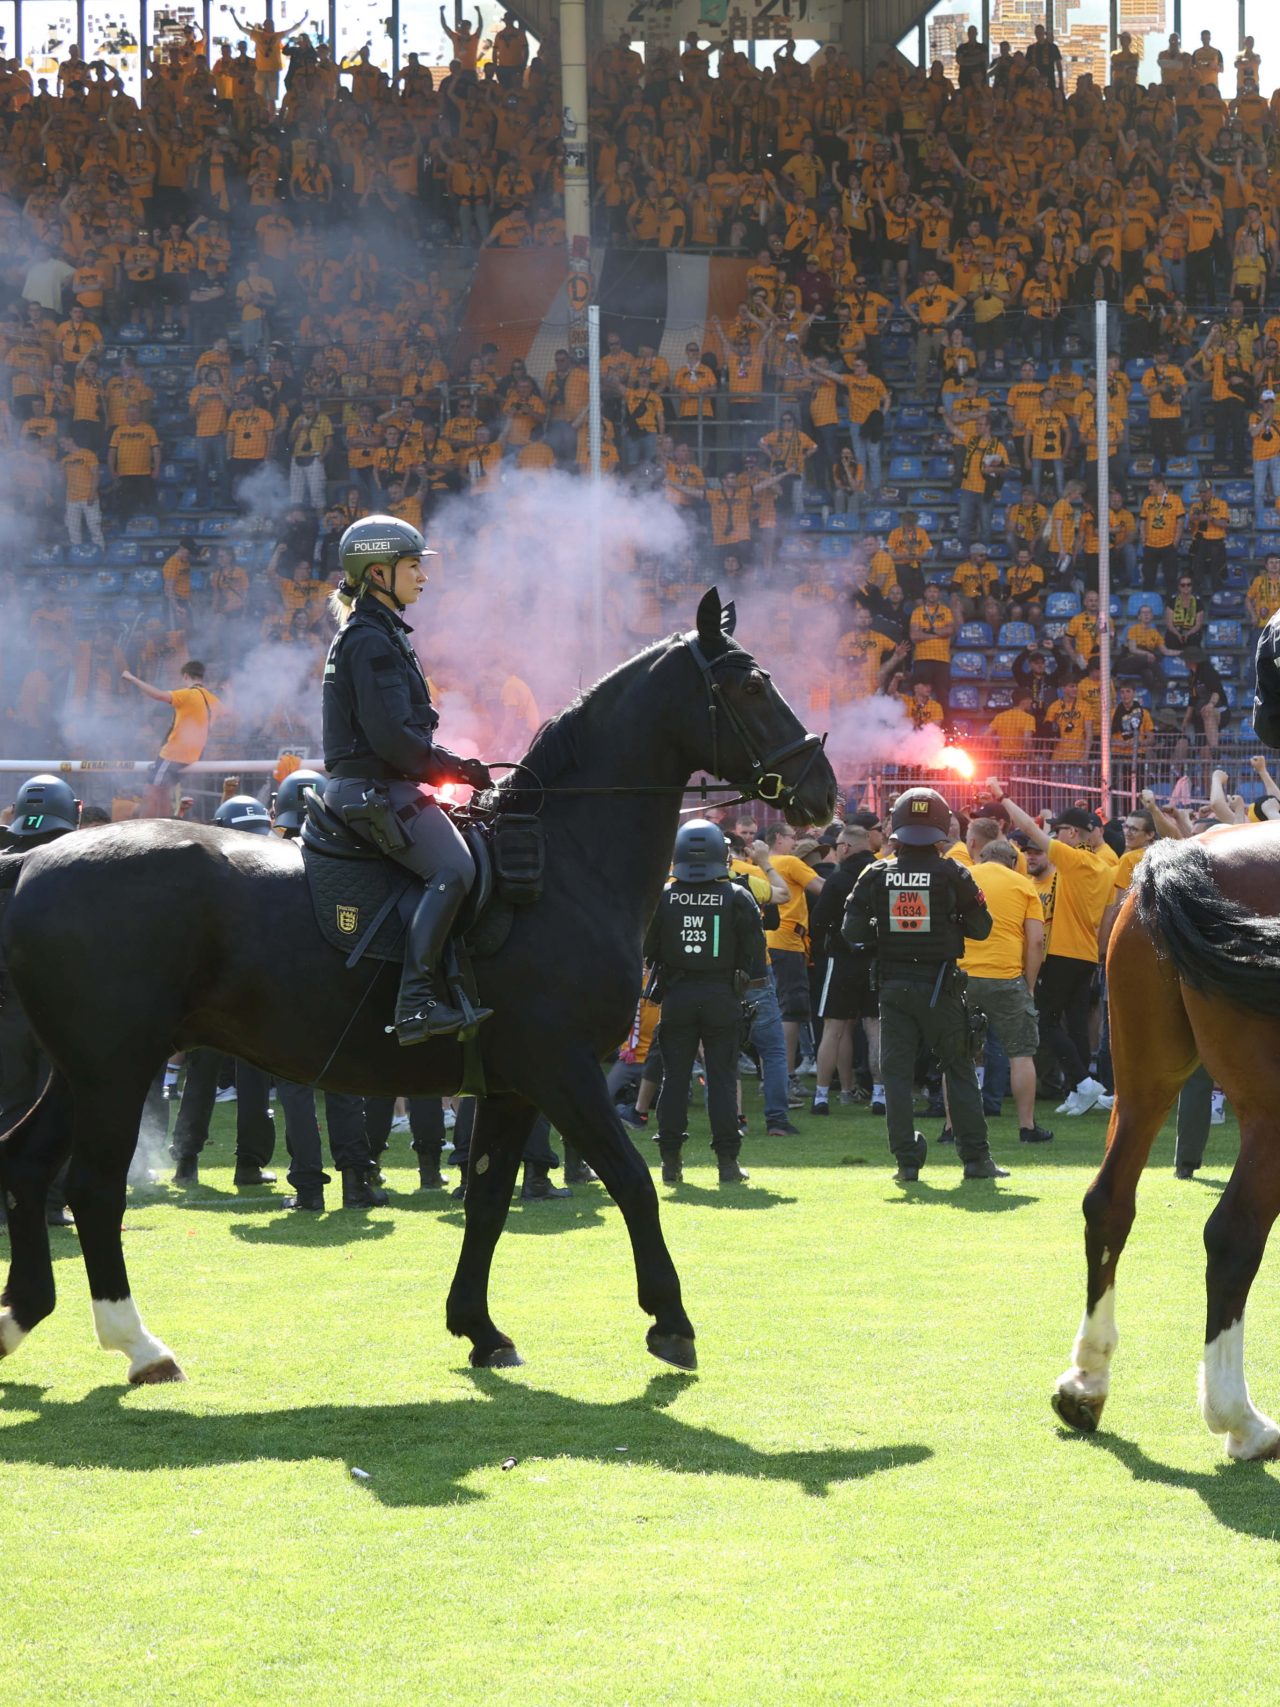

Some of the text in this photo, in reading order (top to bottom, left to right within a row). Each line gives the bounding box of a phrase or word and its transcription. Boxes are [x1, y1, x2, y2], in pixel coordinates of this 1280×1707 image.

[120, 432, 146, 440] DYNAMO
[354, 541, 390, 552] POLIZEI
[913, 802, 928, 813] IV
[885, 872, 931, 887] POLIZEI
[669, 893, 723, 906] POLIZEI
[900, 891, 919, 903] BW
[896, 905, 923, 917] 1634
[683, 916, 704, 928] BW
[680, 930, 707, 942] 1233
